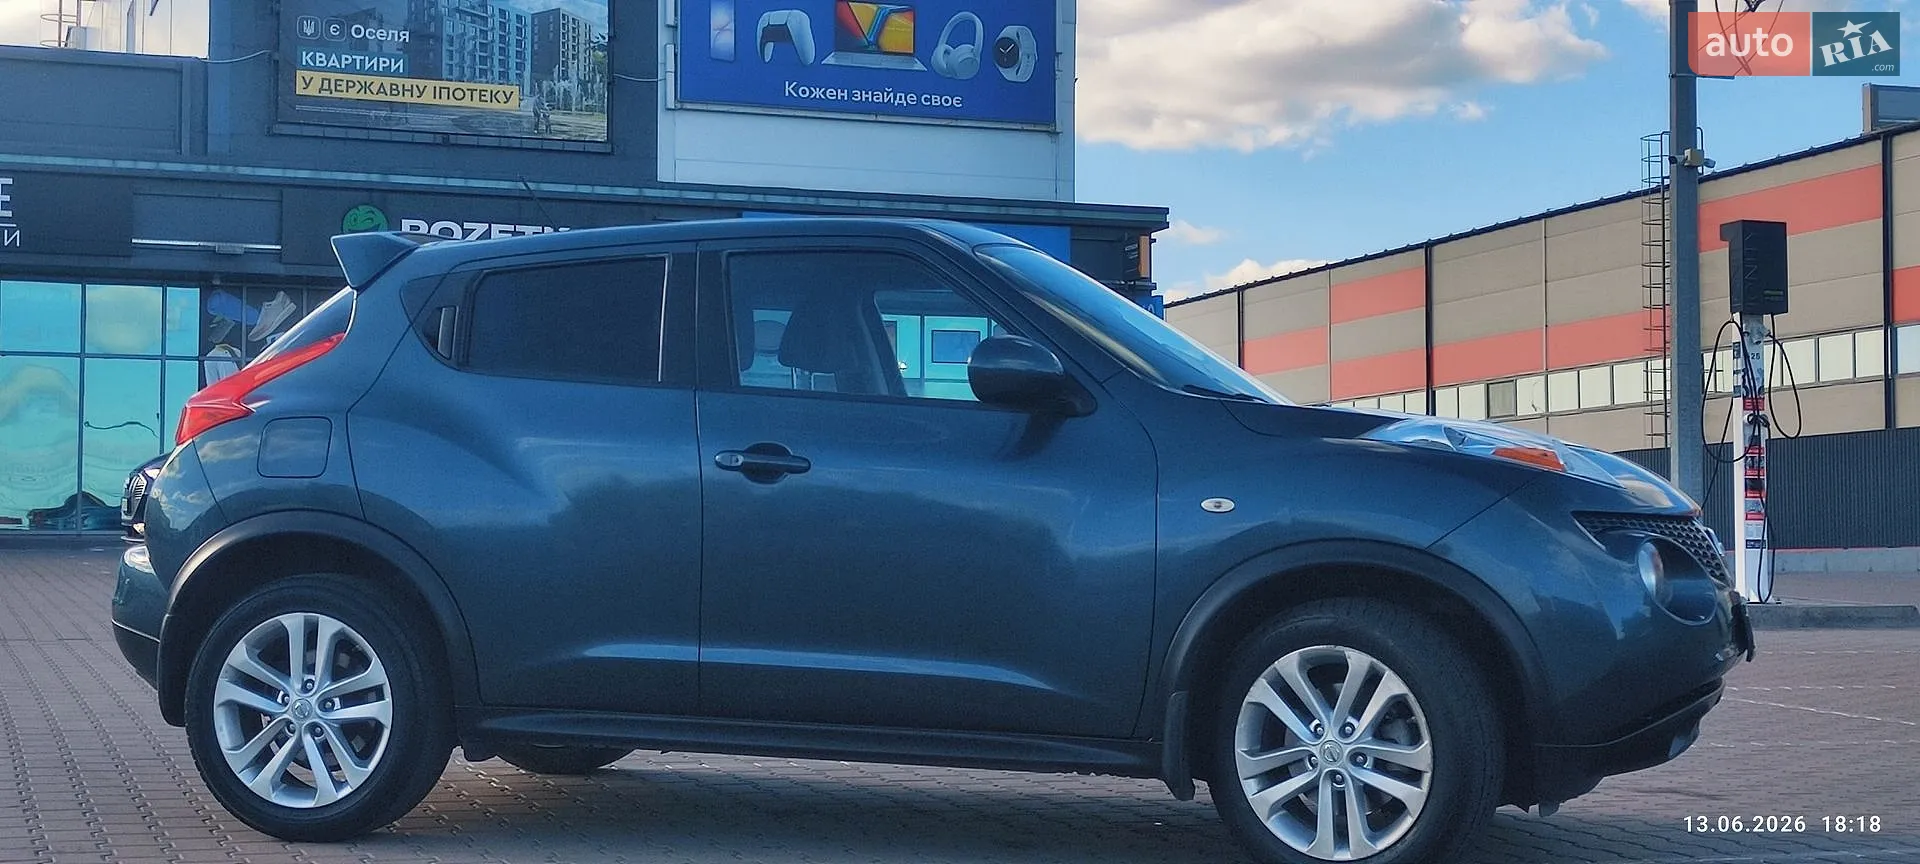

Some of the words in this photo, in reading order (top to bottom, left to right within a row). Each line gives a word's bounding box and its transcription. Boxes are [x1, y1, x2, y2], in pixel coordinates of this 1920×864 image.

[350, 24, 410, 43] Оселя
[301, 51, 404, 73] КВАРТИРИ
[301, 76, 313, 90] У
[318, 78, 427, 98] ДЕРЖАВНУ
[433, 86, 514, 104] ІПОТЕКУ
[784, 80, 848, 100] Кожен
[851, 87, 917, 106] знайде
[921, 93, 963, 107] своє
[401, 218, 571, 242] ROZET
